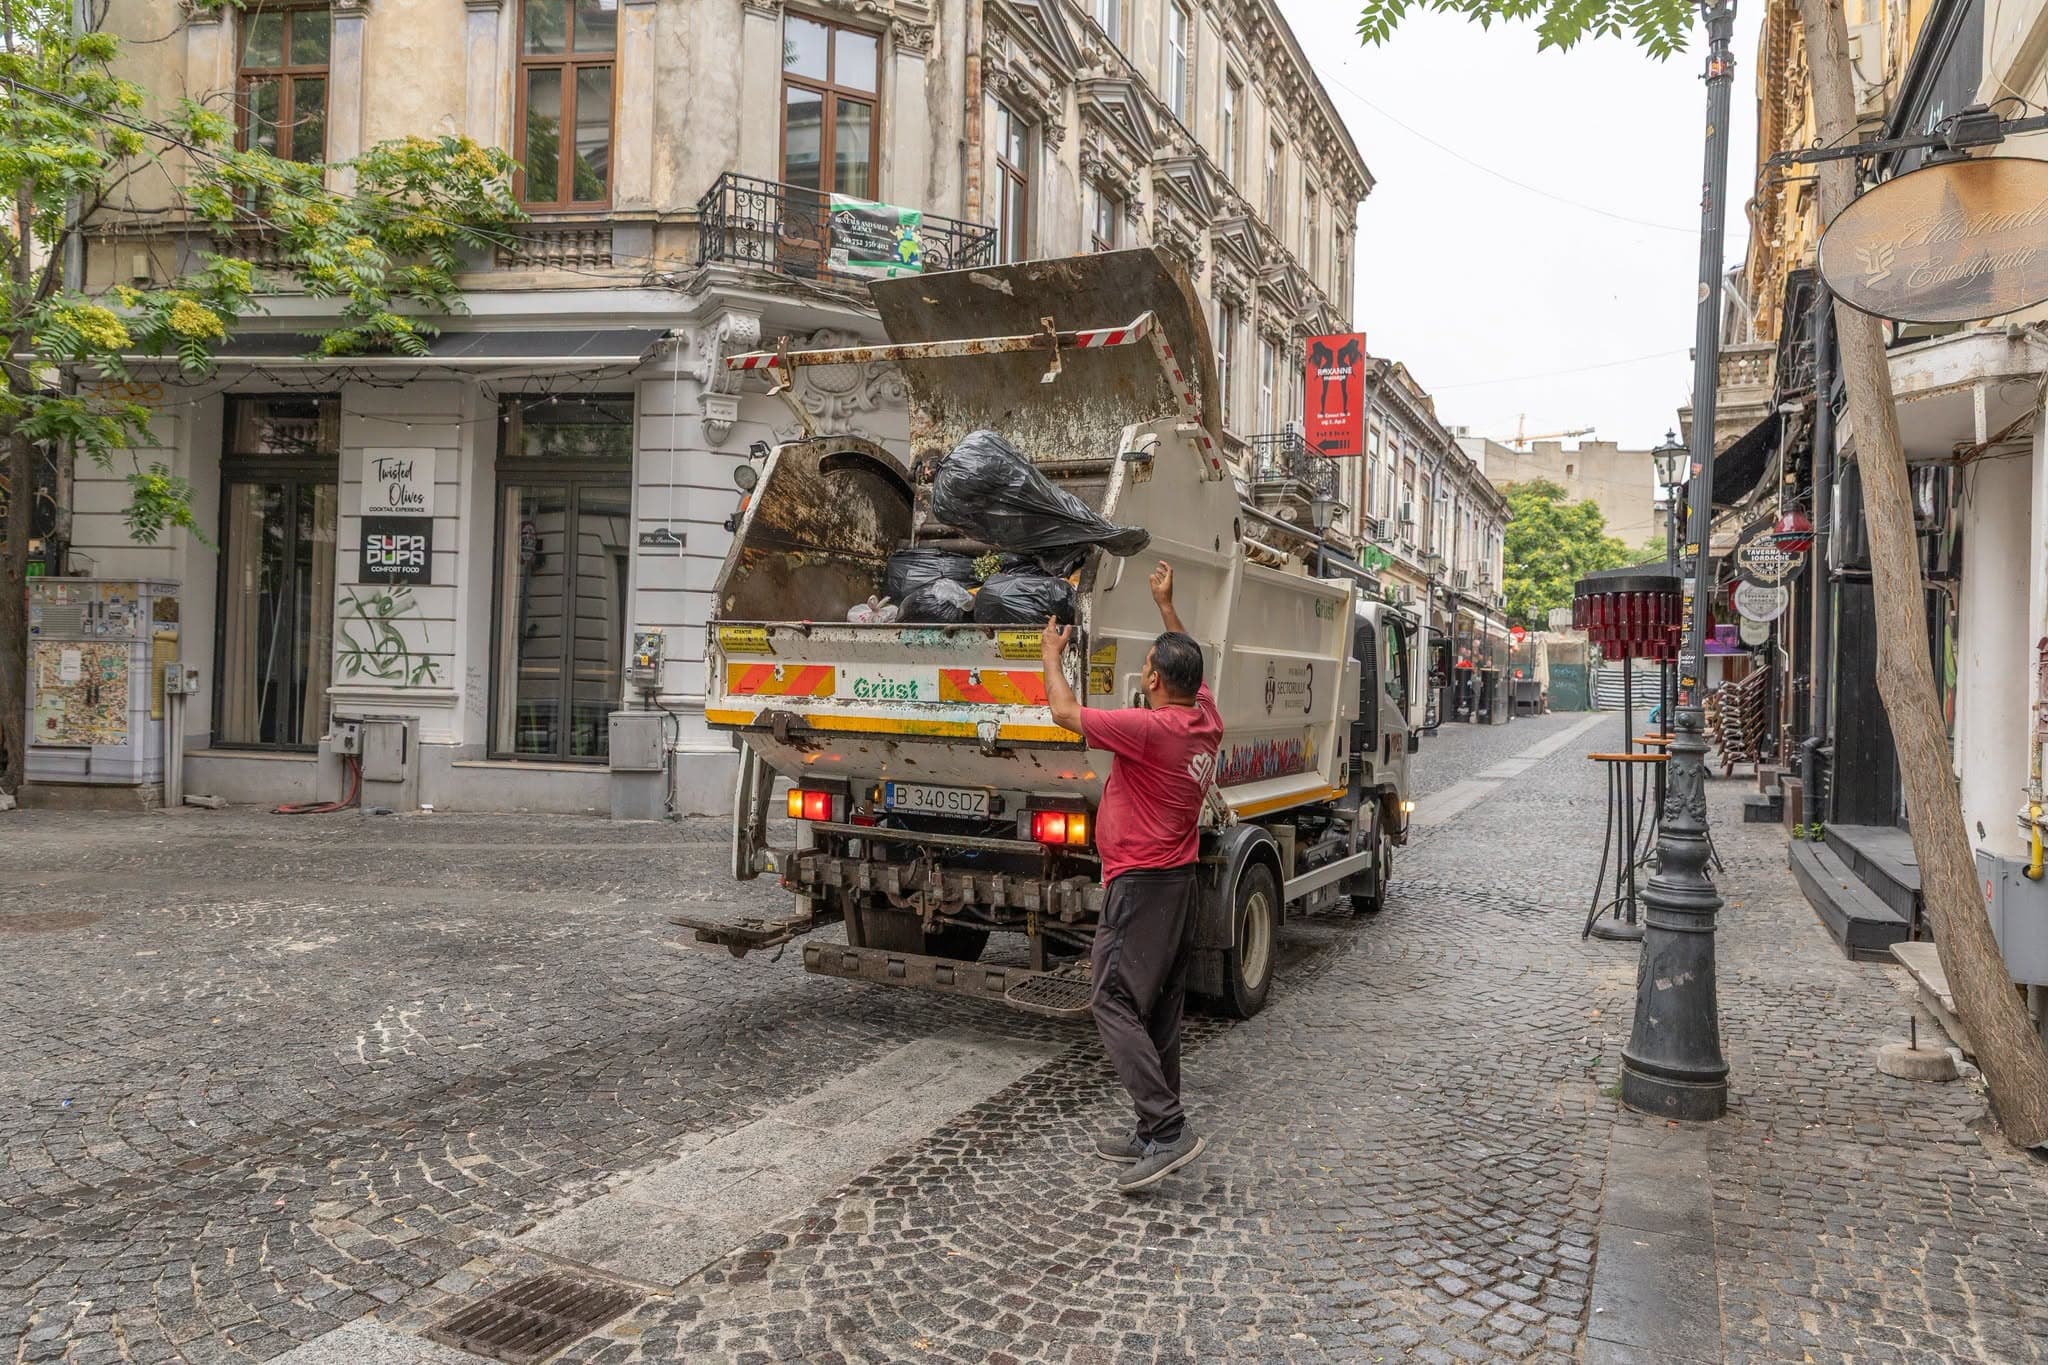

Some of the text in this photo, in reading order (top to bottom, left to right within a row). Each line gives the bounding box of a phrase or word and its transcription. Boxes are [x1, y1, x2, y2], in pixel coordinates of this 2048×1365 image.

[1317, 366, 1353, 376] ROXANNE
[371, 457, 414, 482] Twisted
[389, 482, 424, 506] Olives
[366, 534, 425, 550] SUPA
[366, 550, 425, 566] DUPA
[853, 677, 919, 700] Grüst
[896, 787, 908, 806] B
[914, 789, 945, 809] 340
[948, 791, 985, 813] SDZ
